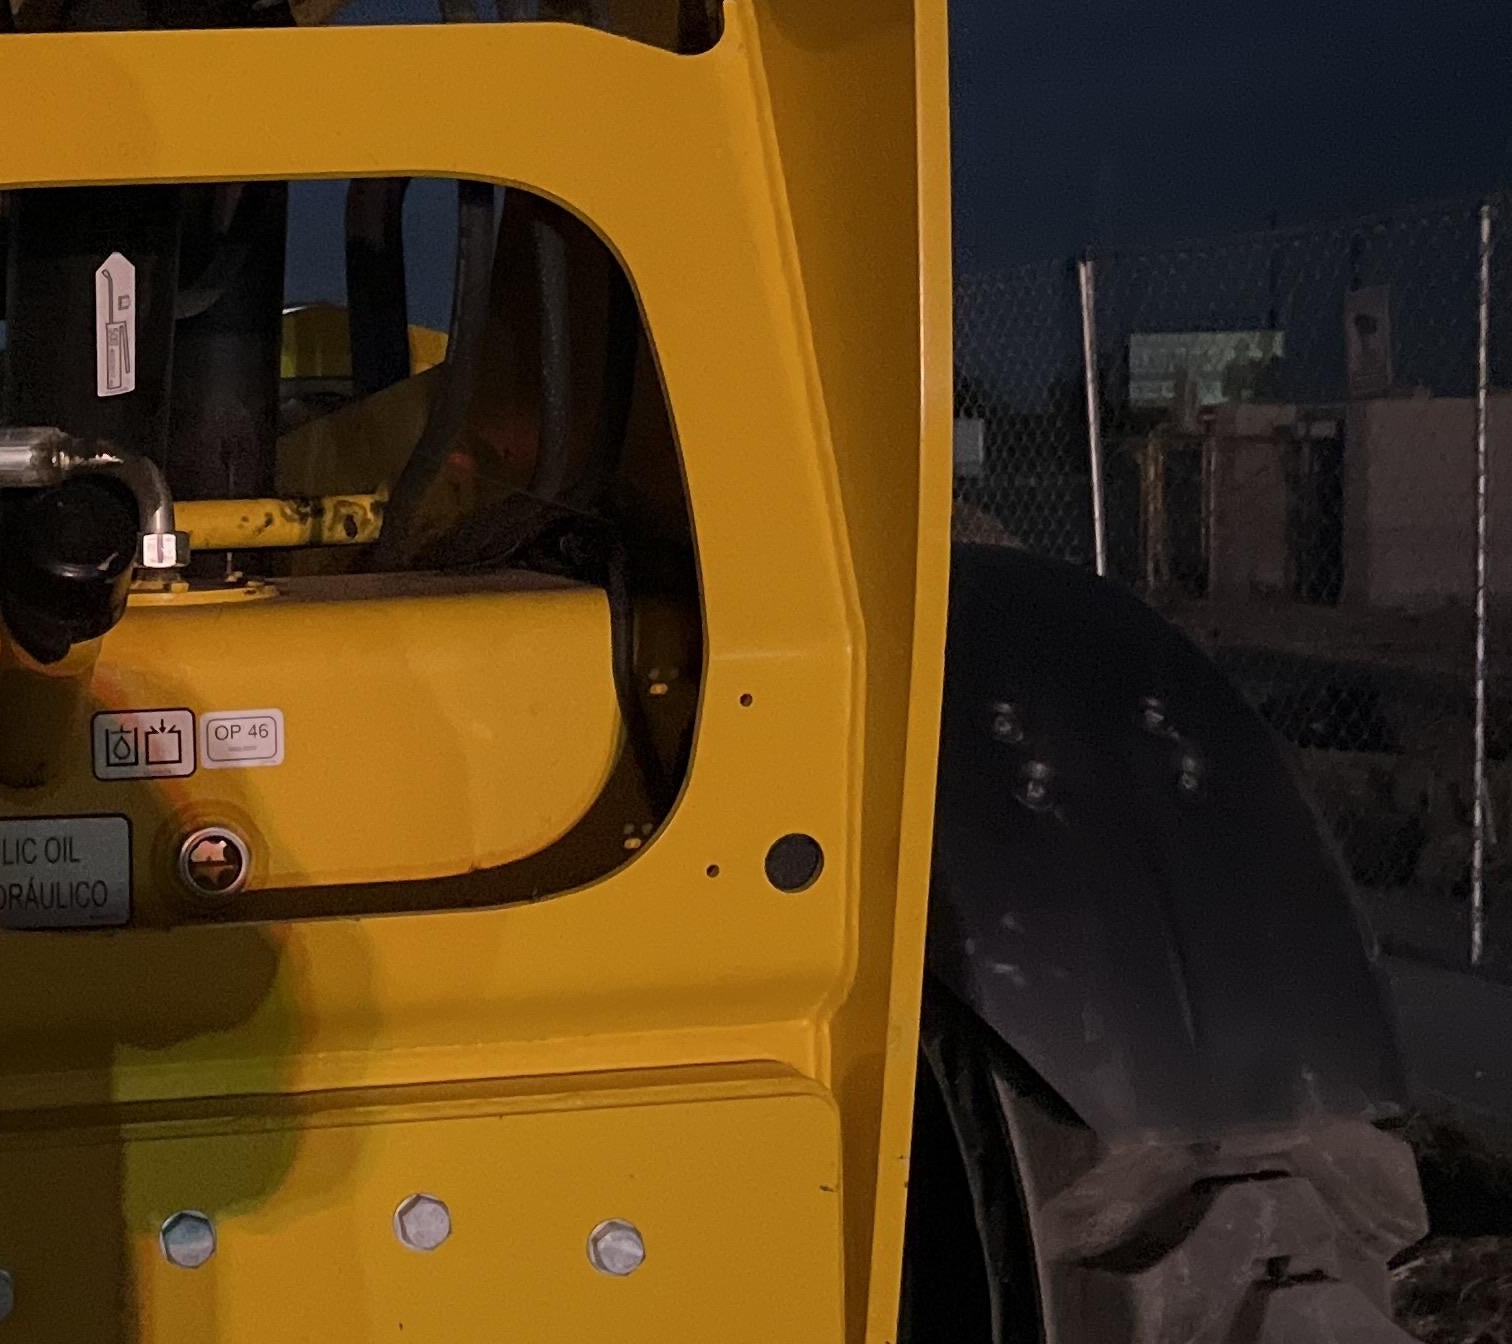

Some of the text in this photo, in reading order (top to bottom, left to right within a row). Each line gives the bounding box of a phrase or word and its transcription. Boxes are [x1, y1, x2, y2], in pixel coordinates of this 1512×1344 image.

[214, 723, 269, 740] OP 46
[44, 836, 80, 863] OIL
